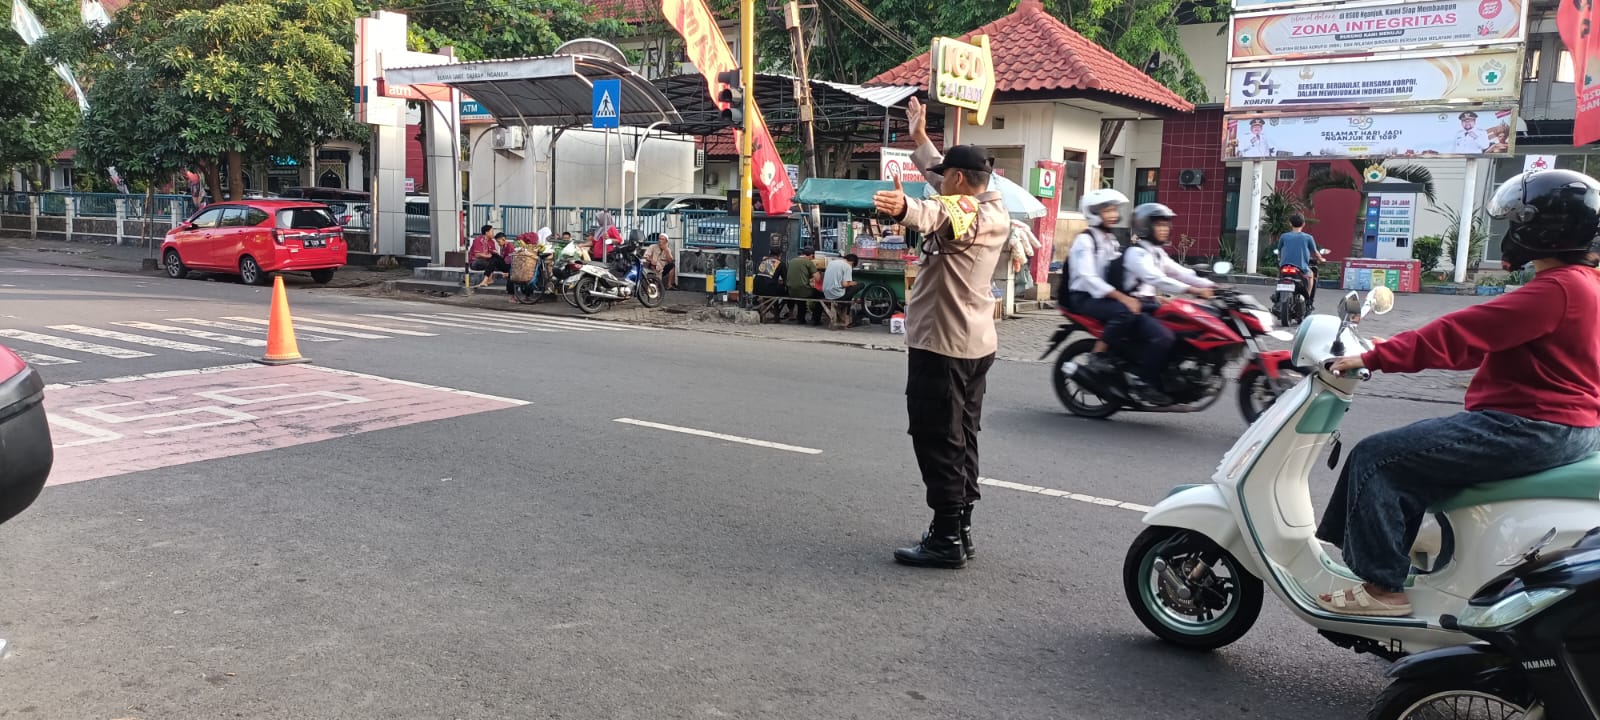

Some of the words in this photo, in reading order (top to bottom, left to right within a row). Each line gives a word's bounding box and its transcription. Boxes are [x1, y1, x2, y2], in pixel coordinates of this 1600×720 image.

[1402, 7, 1416, 15] Siap
[1417, 4, 1457, 13] Membangun
[1291, 23, 1340, 36] ZONA
[1345, 13, 1457, 32] INTEGRITAS
[942, 45, 983, 80] IGD
[1361, 80, 1392, 88] BERSAMA
[389, 85, 412, 96] atm
[1361, 87, 1395, 95] INDONESIA
[1395, 85, 1413, 93] MAJU
[462, 104, 478, 113] ATM
[1522, 659, 1556, 669] YAMAHA
